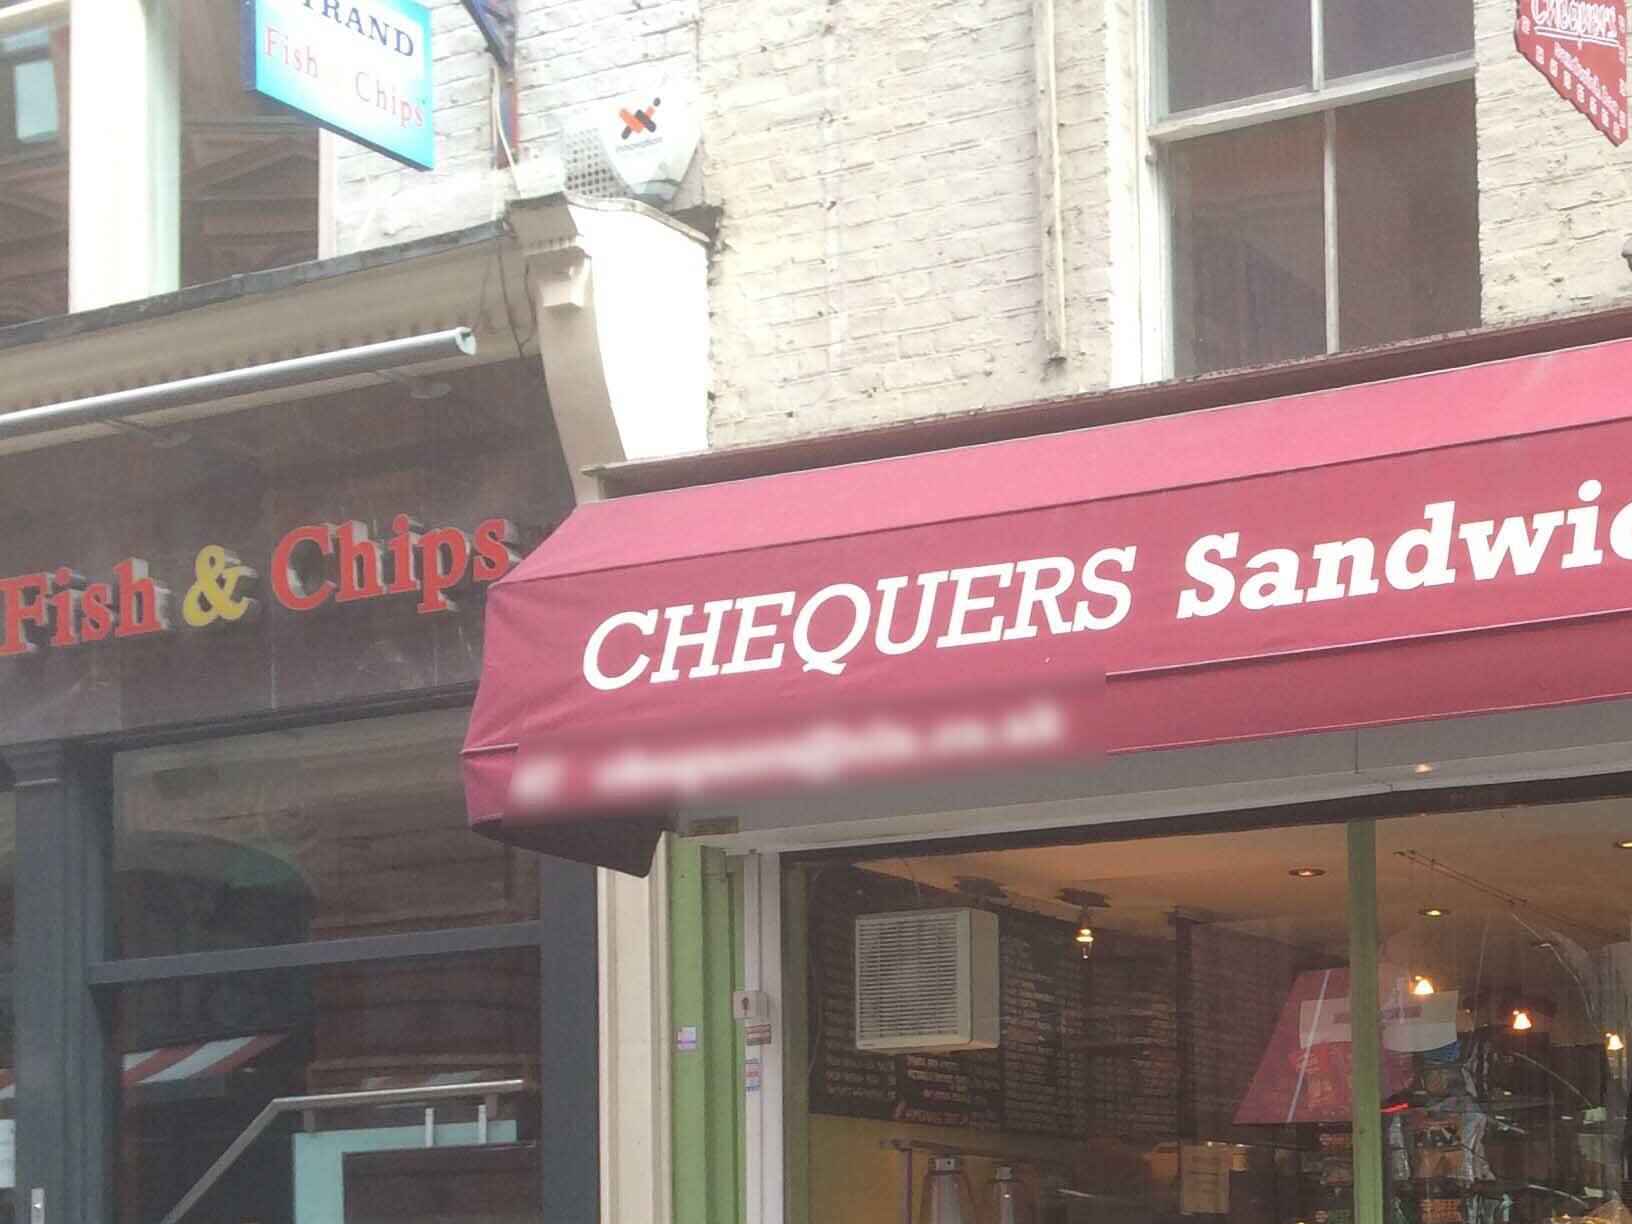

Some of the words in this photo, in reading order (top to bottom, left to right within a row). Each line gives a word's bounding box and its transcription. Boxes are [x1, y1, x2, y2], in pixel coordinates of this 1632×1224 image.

[264, 26, 319, 78] Fish
[355, 71, 424, 128] Chips
[0, 557, 165, 656] Fish
[183, 544, 250, 627] &
[271, 513, 515, 614] Chips
[581, 546, 1136, 691] CHEQUERS
